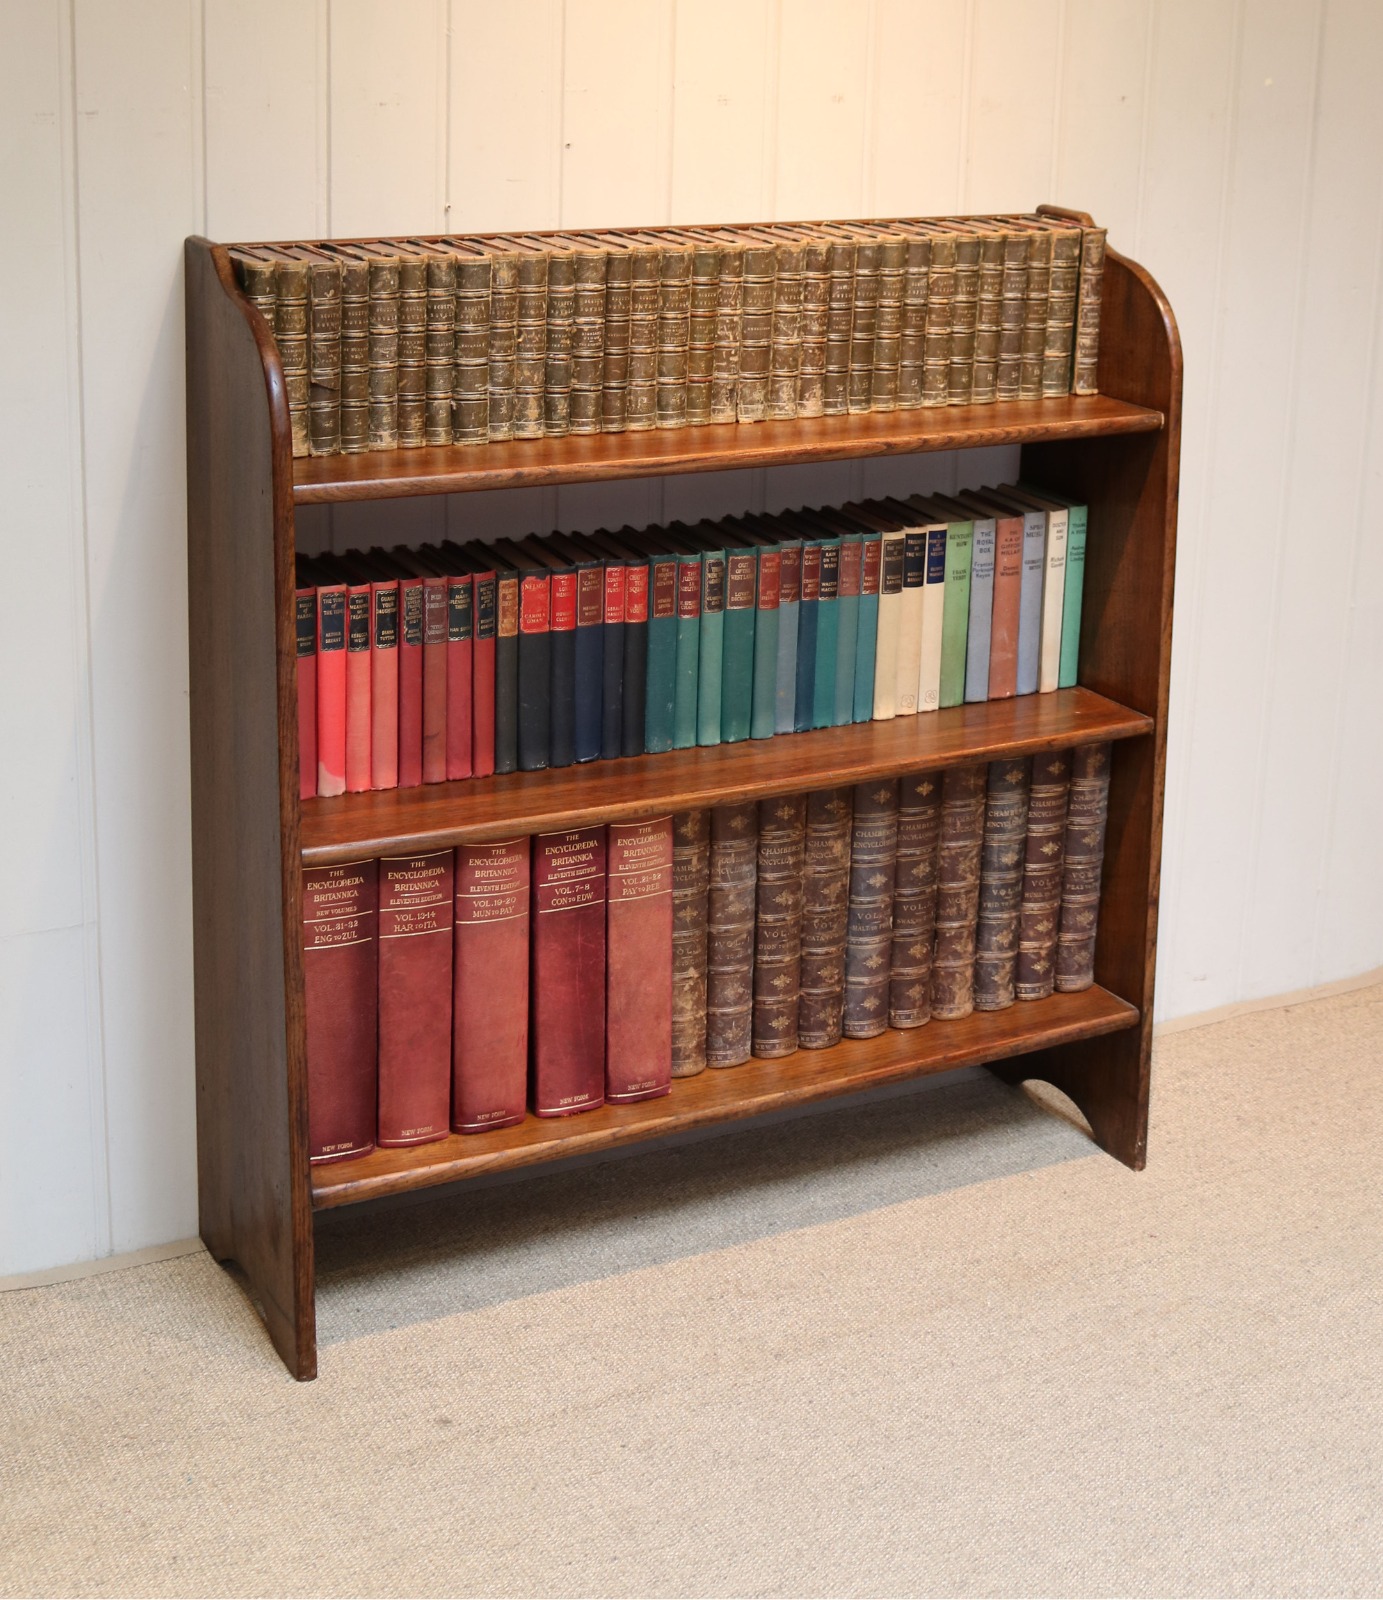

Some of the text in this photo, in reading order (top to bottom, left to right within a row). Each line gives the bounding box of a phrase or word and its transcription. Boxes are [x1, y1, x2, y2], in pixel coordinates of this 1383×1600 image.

[976, 538, 994, 546] ROYAL
[639, 827, 652, 835] THE
[565, 834, 580, 842] THE
[623, 844, 662, 857] BRITANNICA
[551, 853, 593, 867] BRITANNICA
[474, 867, 518, 879] BRITANNICA
[394, 880, 440, 892] BRITANNICA
[622, 886, 638, 896] PAY
[314, 890, 359, 902] BRITANNICA
[551, 897, 568, 908] CON
[576, 892, 594, 904] EDW
[472, 908, 491, 918] MUN
[499, 905, 515, 915] PAY
[394, 924, 414, 933] HAR
[423, 920, 437, 929] ITA
[314, 933, 333, 944] ENG
[341, 931, 358, 940] ZUL
[628, 1084, 641, 1092] NEW
[560, 1097, 573, 1105] NEW
[477, 1113, 490, 1121] NEW
[401, 1128, 416, 1137] NEW
[322, 1144, 336, 1152] NEW
